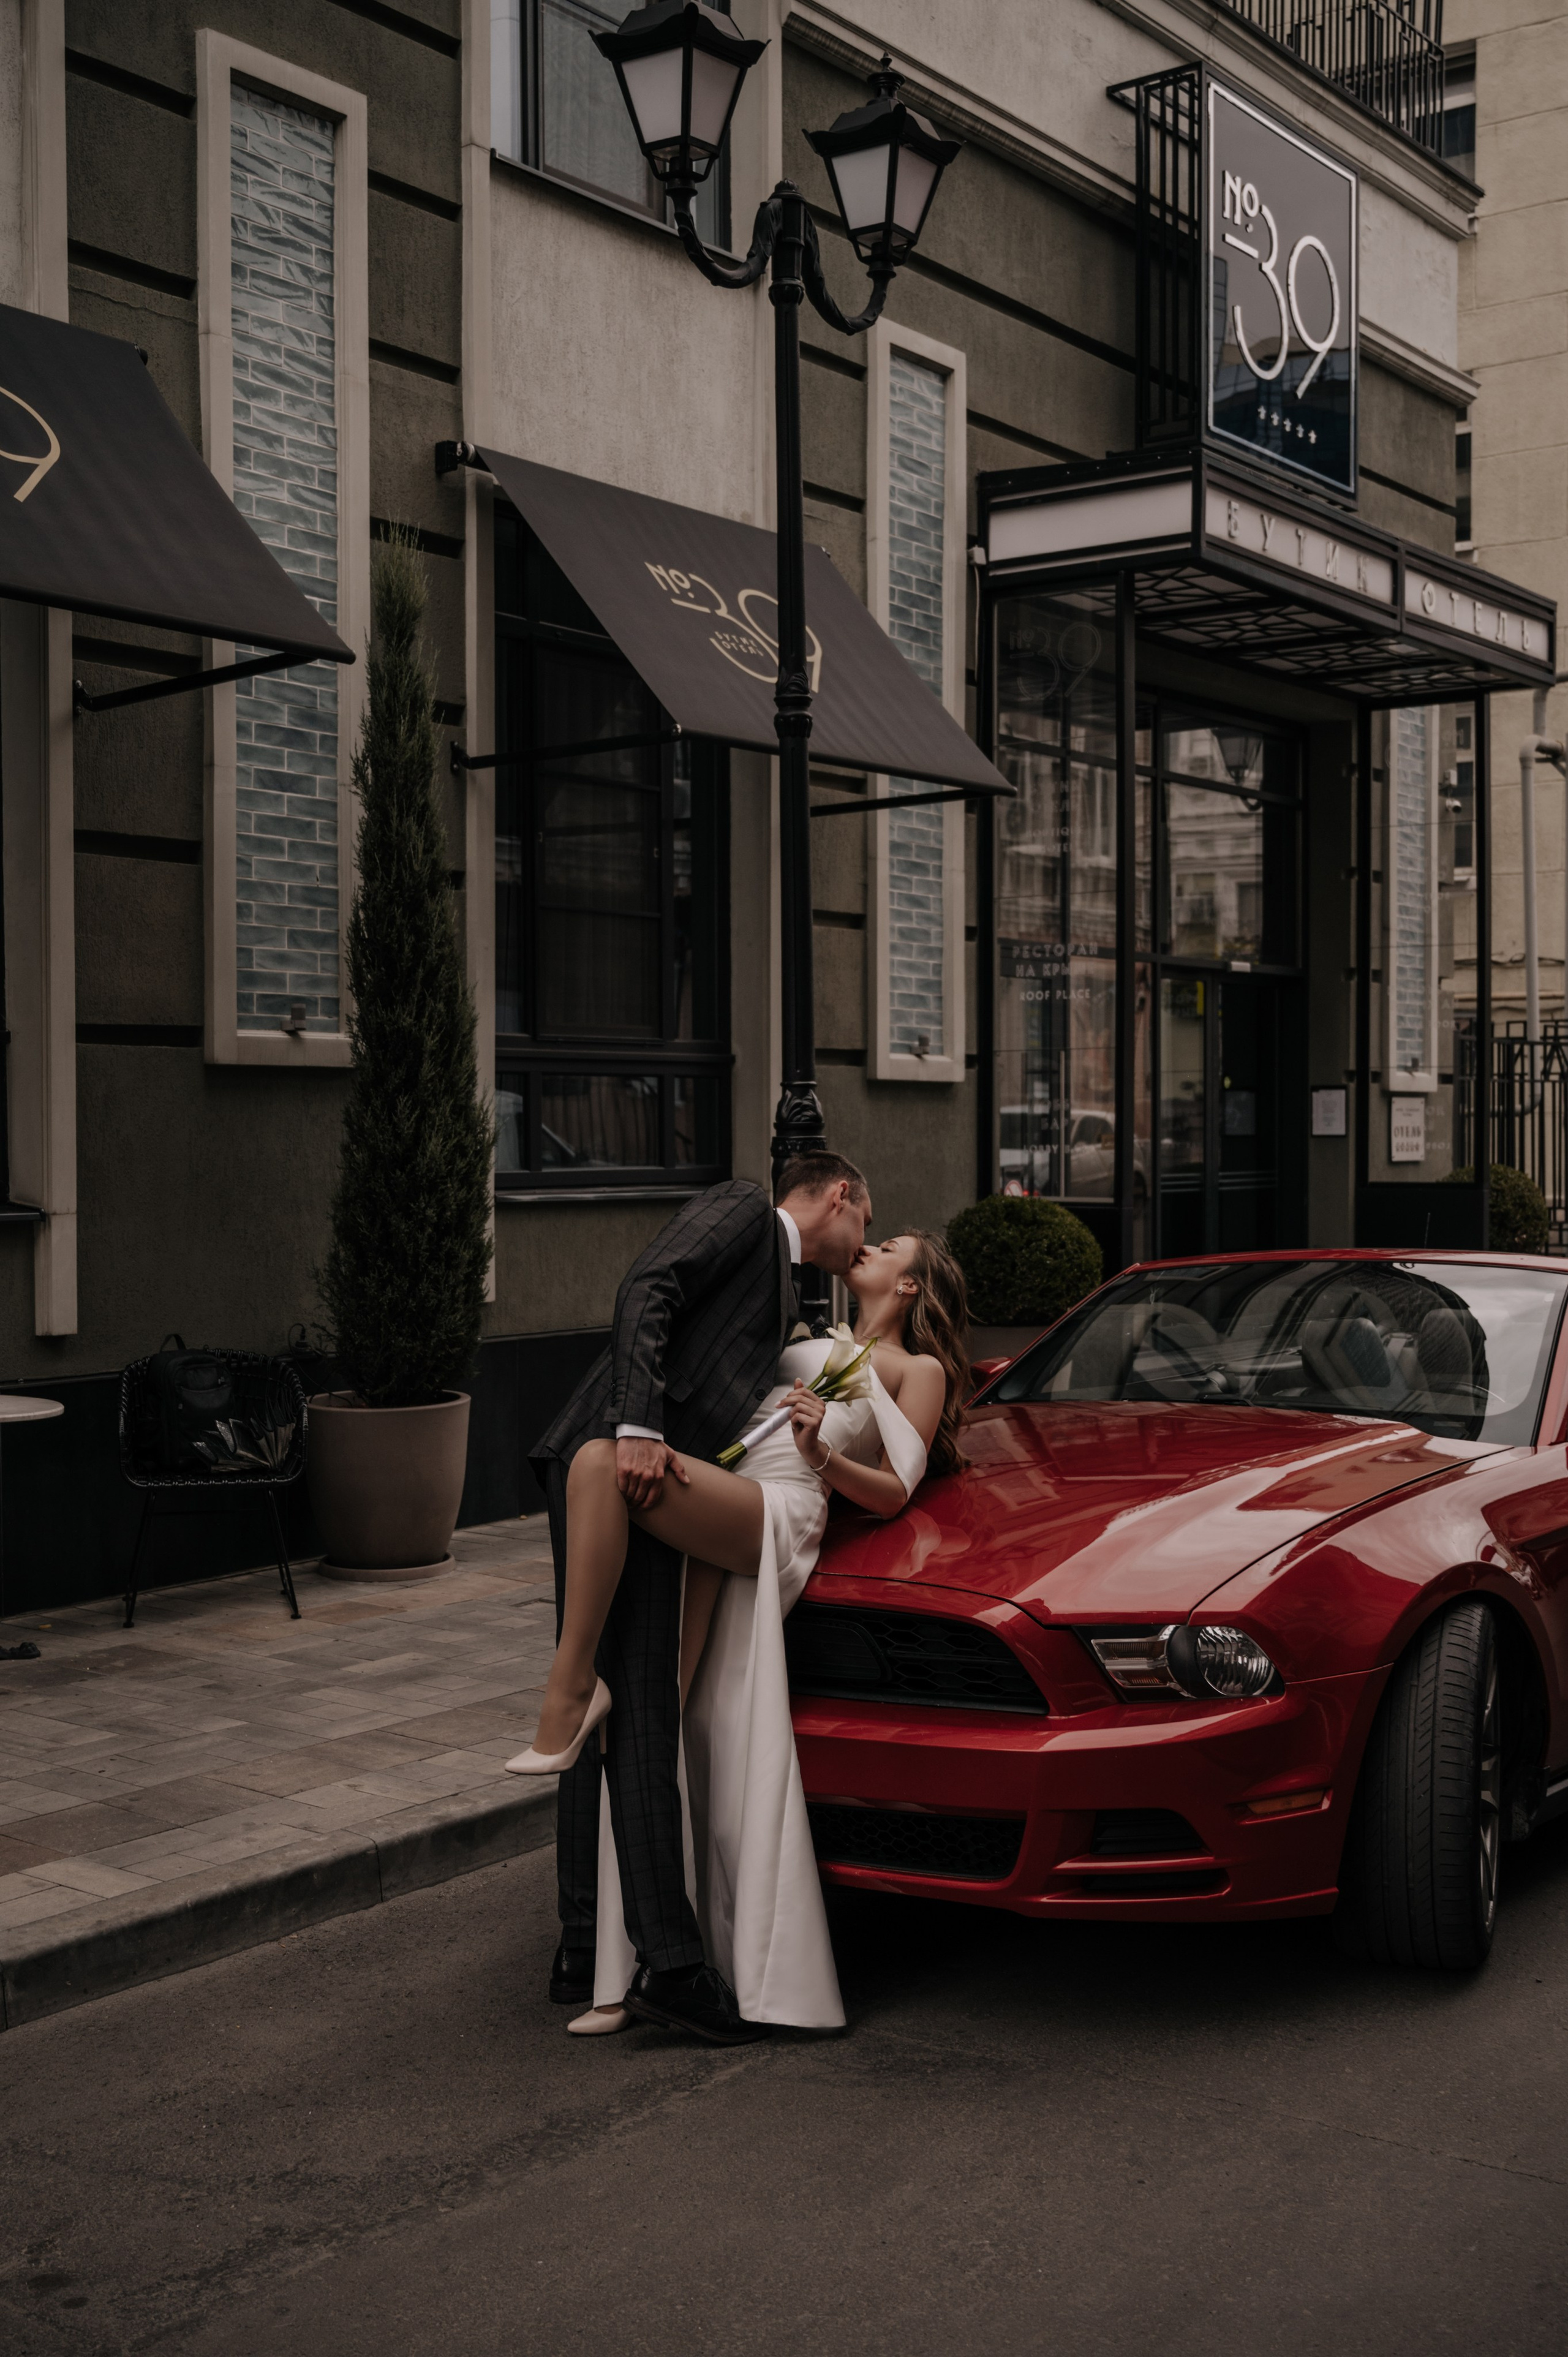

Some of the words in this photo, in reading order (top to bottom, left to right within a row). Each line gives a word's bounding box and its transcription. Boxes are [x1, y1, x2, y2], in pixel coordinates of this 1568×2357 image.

[1225, 204, 1340, 399] 39
[1227, 500, 1370, 592] БУТИК
[1422, 581, 1531, 651] ОТЕЛЬ
[714, 631, 758, 648] БУТИК
[721, 641, 764, 657] ОТЕЛЬ
[1014, 621, 1101, 700] 39
[1012, 942, 1098, 959] РЕСТОРАН
[1016, 965, 1036, 977] НА
[1019, 990, 1050, 1001] ROOF
[1056, 989, 1090, 1000] PLACE
